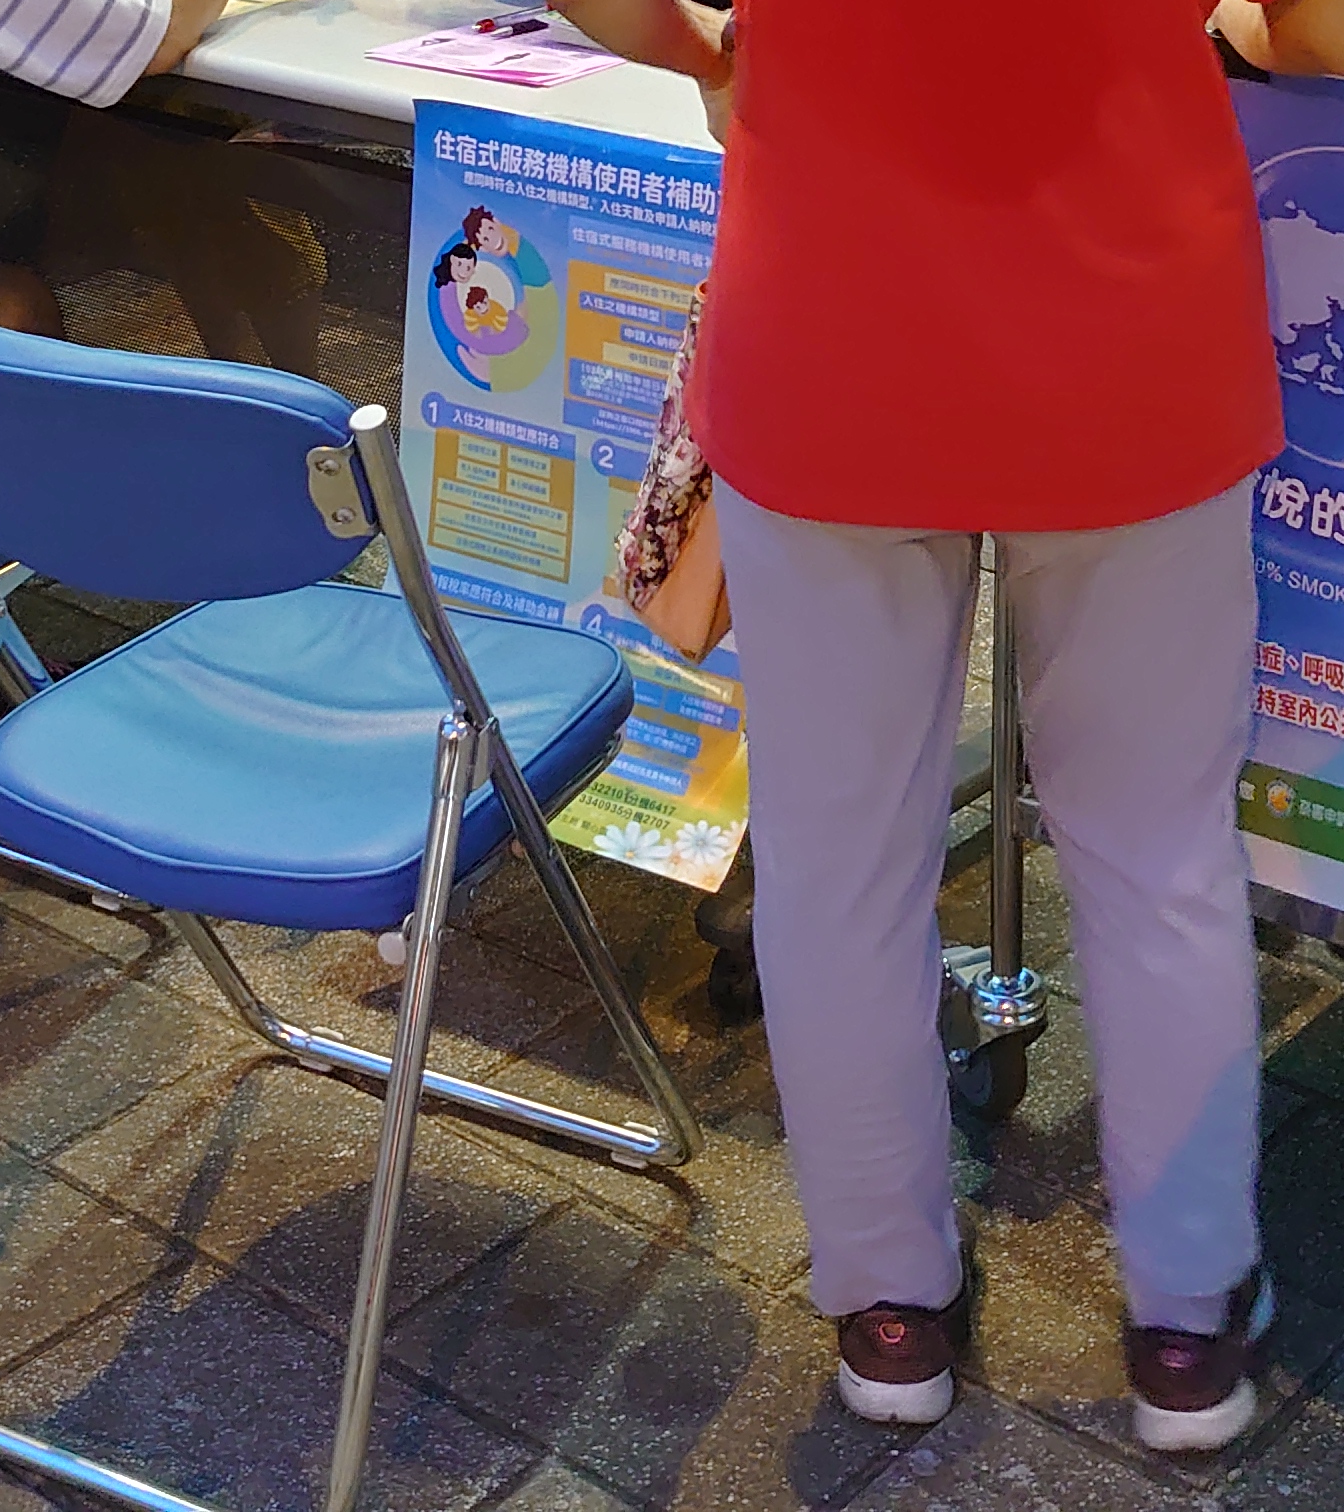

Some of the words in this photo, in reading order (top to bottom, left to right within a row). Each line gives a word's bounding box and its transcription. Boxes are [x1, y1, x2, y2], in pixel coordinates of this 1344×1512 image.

[427, 400, 438, 424] 1
[598, 445, 614, 469] 2
[587, 613, 603, 636] 4
